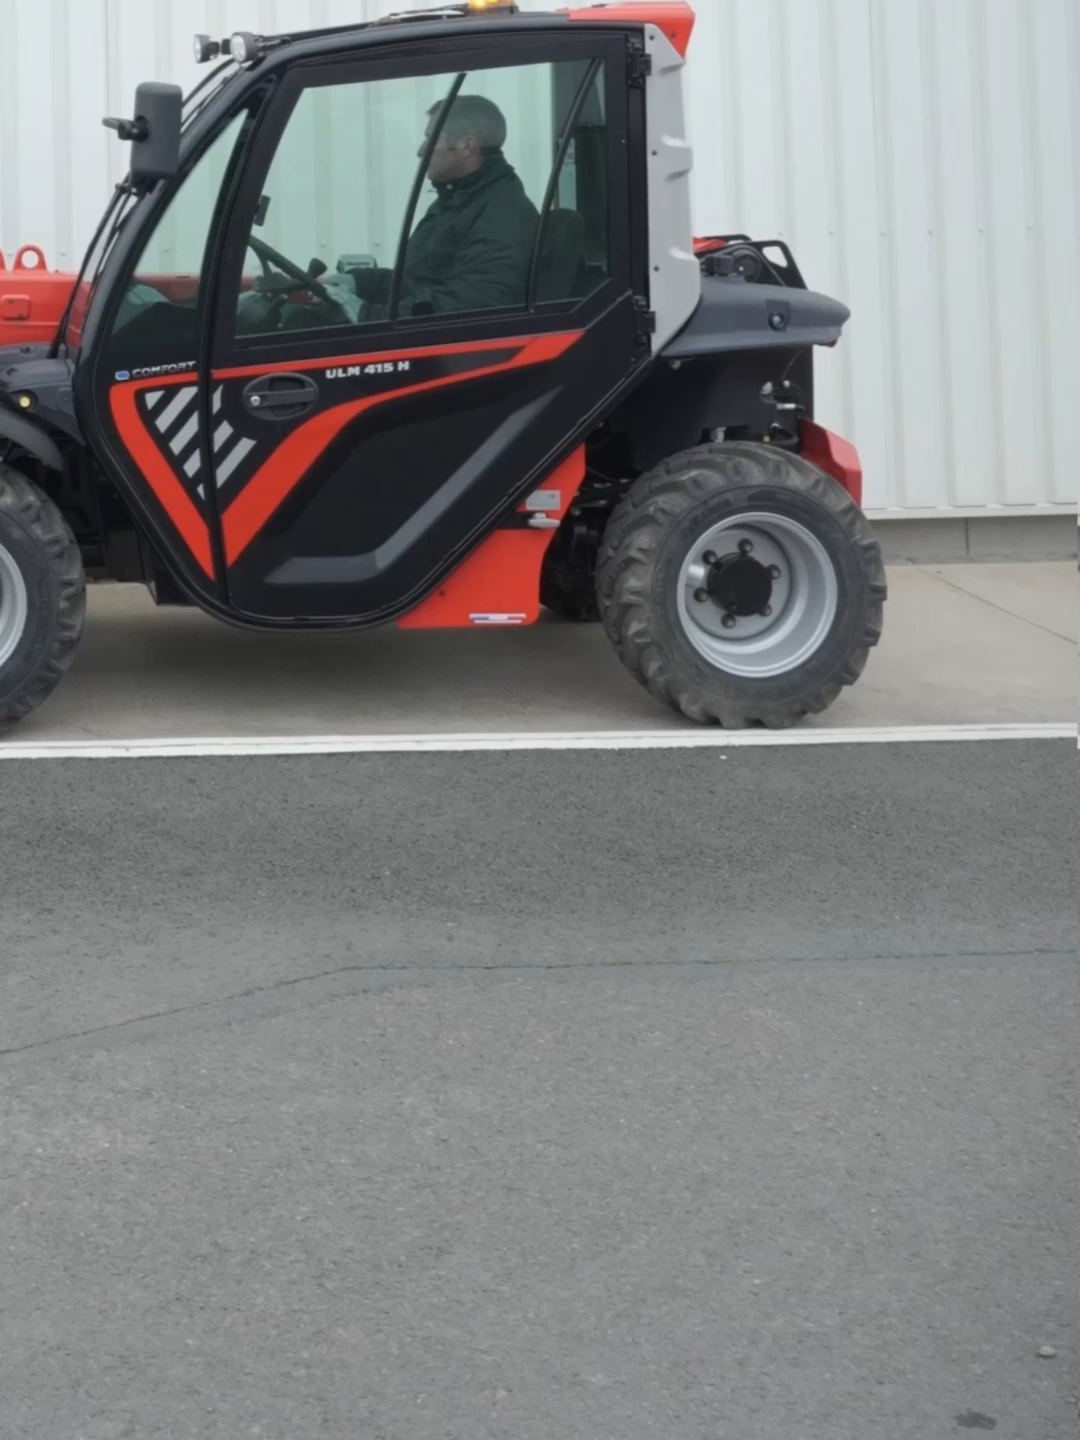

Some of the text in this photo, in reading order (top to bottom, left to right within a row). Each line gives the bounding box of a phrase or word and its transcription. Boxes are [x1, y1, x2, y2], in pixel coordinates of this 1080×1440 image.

[131, 360, 197, 378] COMFORT
[325, 360, 410, 380] ULM 415 H
